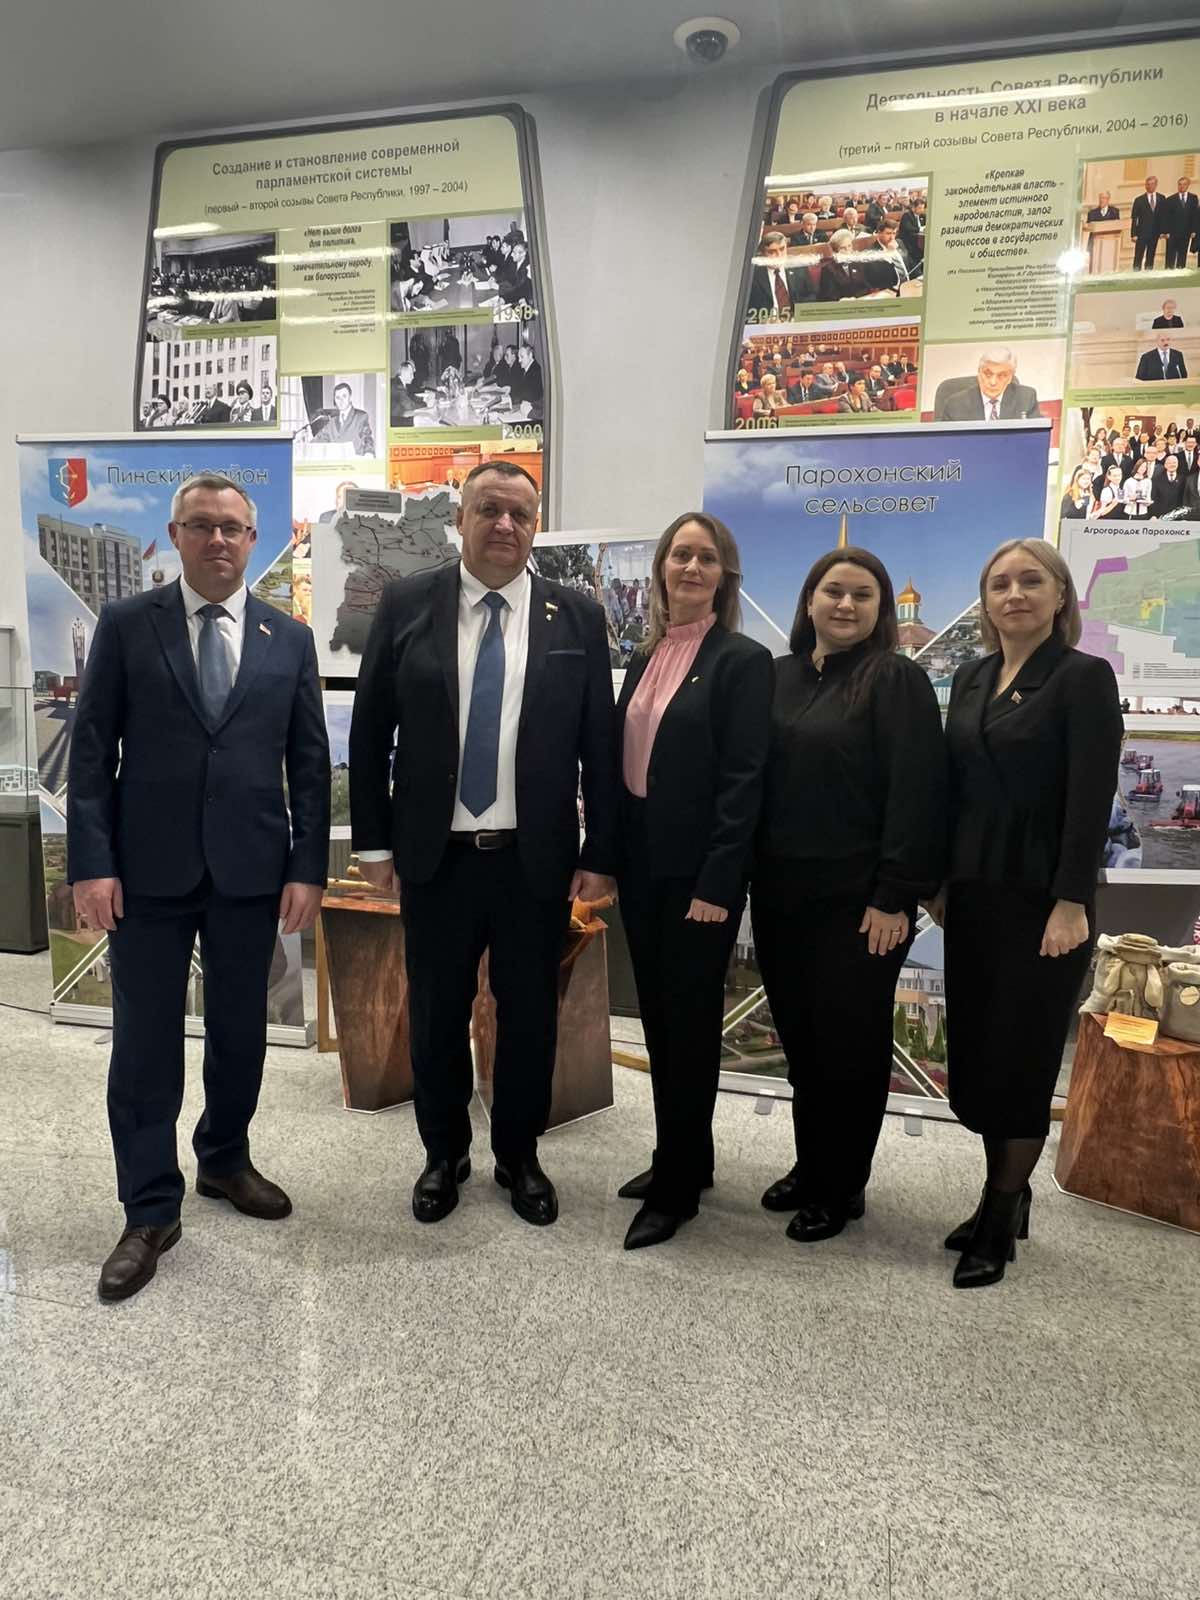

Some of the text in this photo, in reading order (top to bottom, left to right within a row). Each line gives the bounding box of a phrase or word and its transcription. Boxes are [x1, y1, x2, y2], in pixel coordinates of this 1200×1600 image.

[866, 67, 1163, 111] Деятельность Совета Республики
[935, 97, 1087, 122] в начале XXI века
[839, 142, 880, 160] (третий
[895, 138, 930, 152] пятый
[933, 134, 977, 148] созывы
[981, 130, 1023, 144] Совета
[1027, 123, 1102, 140] Республики,
[1106, 118, 1136, 133] 2004
[1152, 113, 1188, 128] 2016)
[212, 138, 460, 176] Создание и становление современной
[256, 165, 412, 191] парламентской системы
[985, 169, 1025, 182] «Крепкая
[945, 183, 1022, 197] законодательная
[1023, 179, 1057, 190] власть
[204, 201, 239, 217] (первый
[249, 198, 279, 211] второй
[281, 198, 314, 208] созывы
[316, 192, 348, 204] Совета
[350, 187, 405, 202] Республики,
[409, 183, 431, 196] 1997
[441, 180, 468, 193] 2004)
[958, 193, 1049, 209] элемент истинного
[953, 205, 1052, 222] народовластия, залог
[940, 218, 1064, 238] развития демократических
[945, 231, 1059, 249] процессов в государстве
[970, 249, 976, 259] и
[504, 424, 542, 439] 2000
[106, 463, 270, 485] Пинский айон
[786, 458, 963, 489] Парохонский
[804, 496, 940, 515] сельсовет
[1083, 526, 1191, 537] Агрогородок Парохонск
